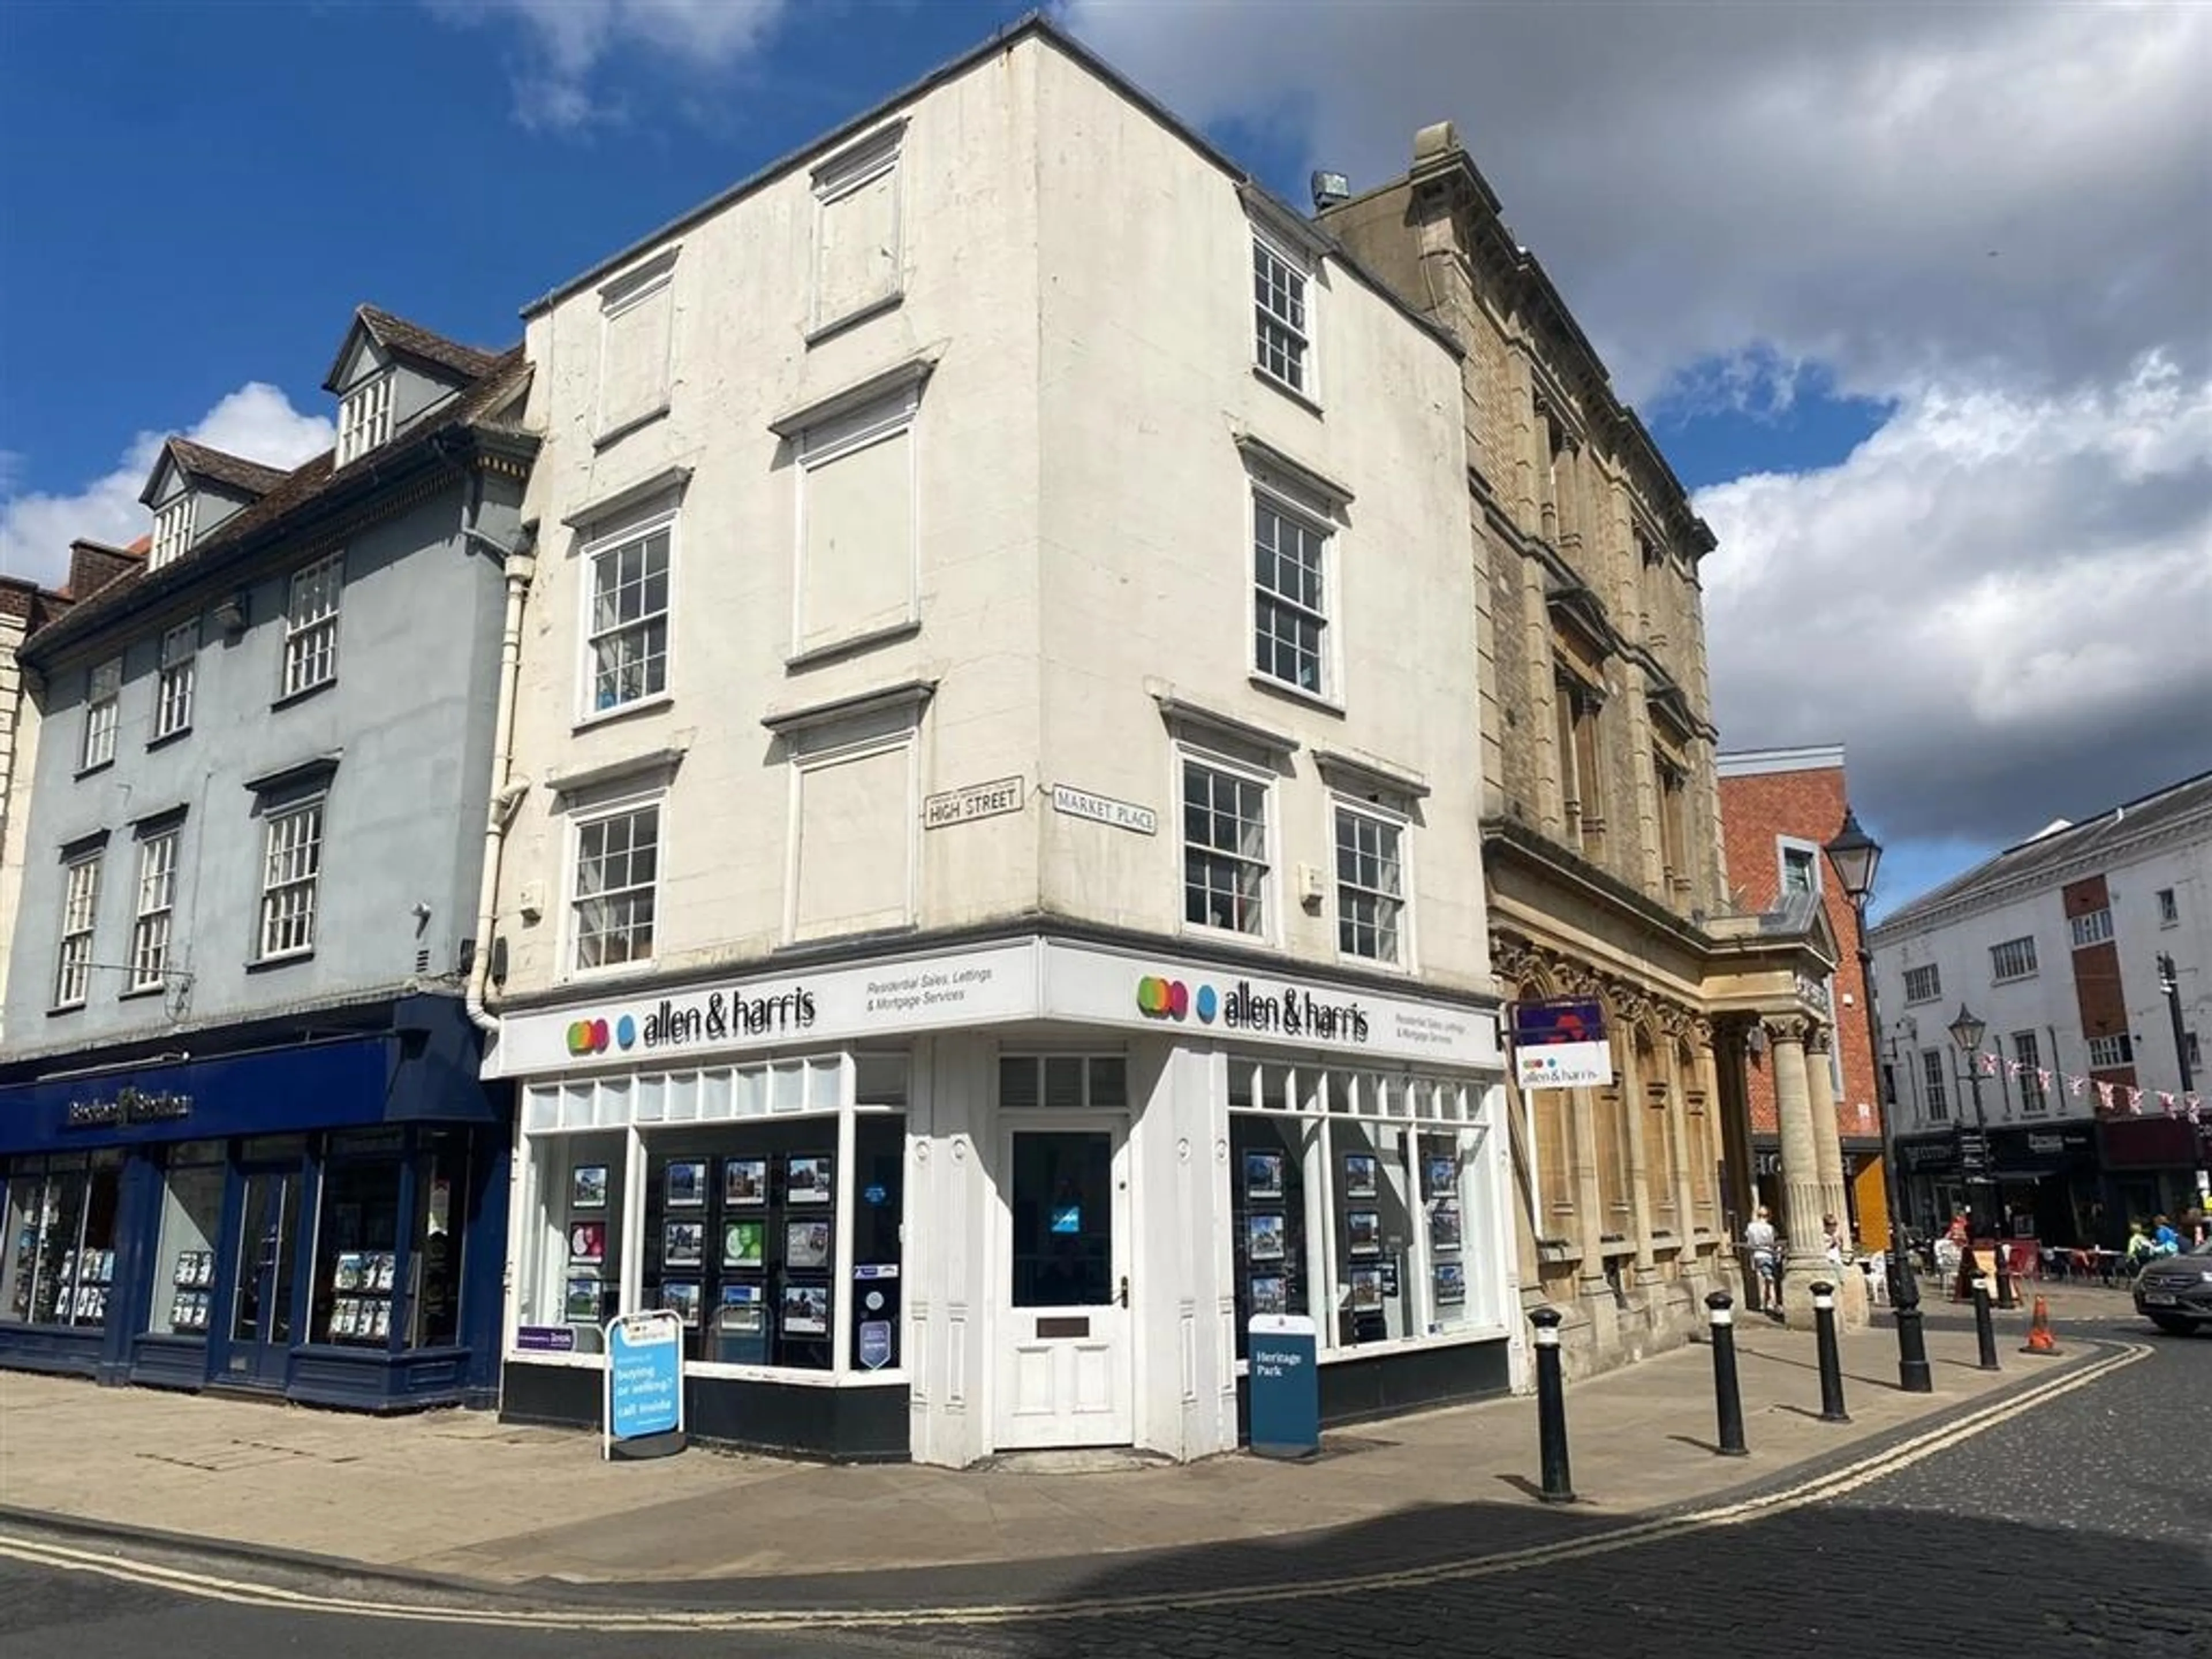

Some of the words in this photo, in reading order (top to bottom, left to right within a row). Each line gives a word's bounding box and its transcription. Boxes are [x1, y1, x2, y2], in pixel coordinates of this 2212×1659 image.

[930, 801, 960, 822] HIGH
[965, 788, 1016, 816] STREET
[1058, 790, 1111, 819] MARKET
[1116, 806, 1153, 828] PLACE
[643, 999, 702, 1047] allen
[706, 991, 728, 1040] &
[732, 986, 816, 1036] harris
[1224, 979, 1279, 1031] allen
[1283, 987, 1302, 1036] &
[1304, 991, 1369, 1043] harris
[1522, 1072, 1550, 1084] allen
[1551, 1070, 1560, 1082] &
[1257, 1351, 1301, 1366] Heritage
[1257, 1365, 1282, 1377] Park
